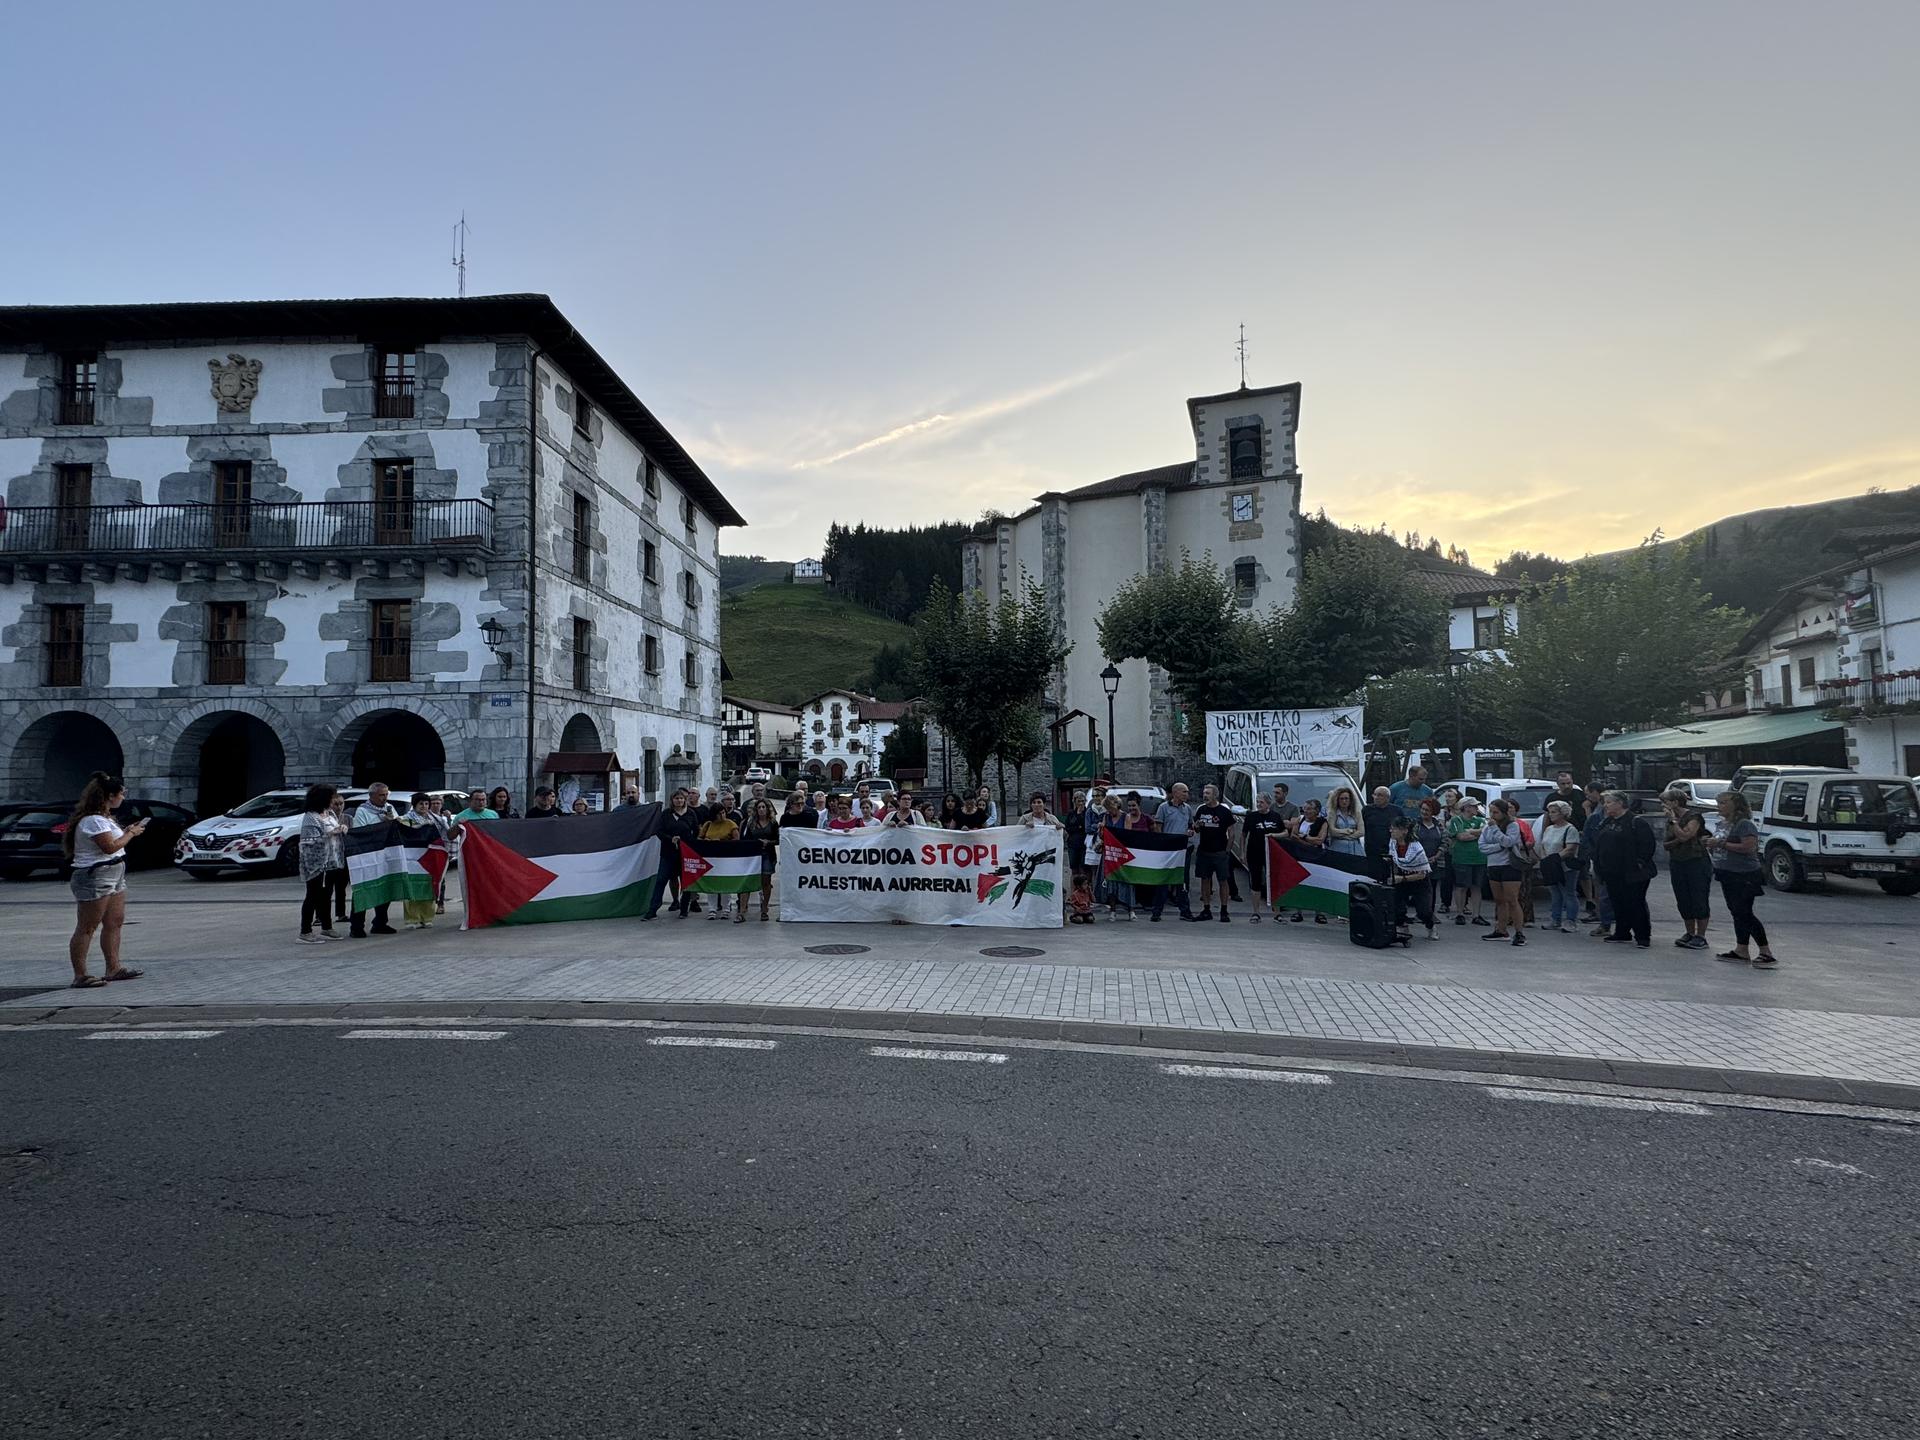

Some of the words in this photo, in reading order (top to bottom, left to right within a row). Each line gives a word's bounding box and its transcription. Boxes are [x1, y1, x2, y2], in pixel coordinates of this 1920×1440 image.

[1216, 711, 1300, 730] URUMEAKO
[1218, 728, 1301, 747] MENDIETAN
[1218, 744, 1314, 761] MAKROEOLIKORIK
[798, 847, 916, 865] GENOZIDIOA
[920, 843, 998, 868] STOP!
[798, 875, 885, 892] PALESTINA
[888, 876, 972, 893] AURRERA!
